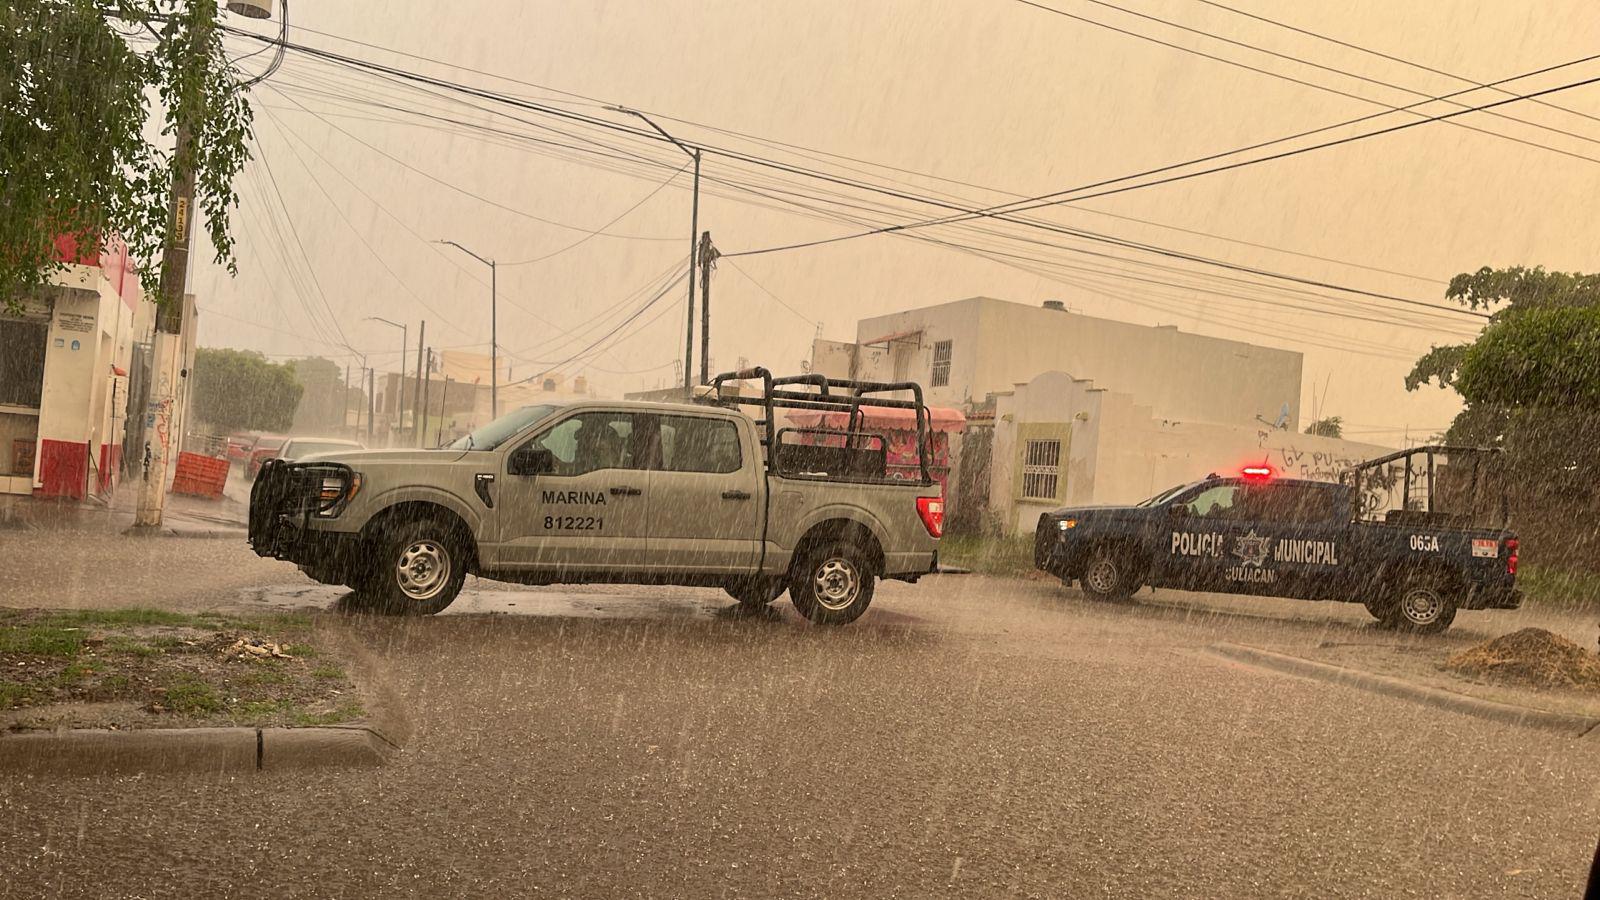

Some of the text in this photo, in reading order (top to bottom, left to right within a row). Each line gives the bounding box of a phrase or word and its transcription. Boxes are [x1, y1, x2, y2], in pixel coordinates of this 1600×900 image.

[542, 490, 606, 505] MARINA
[544, 516, 603, 530] 812221
[1274, 539, 1338, 565] MUNICIPAL
